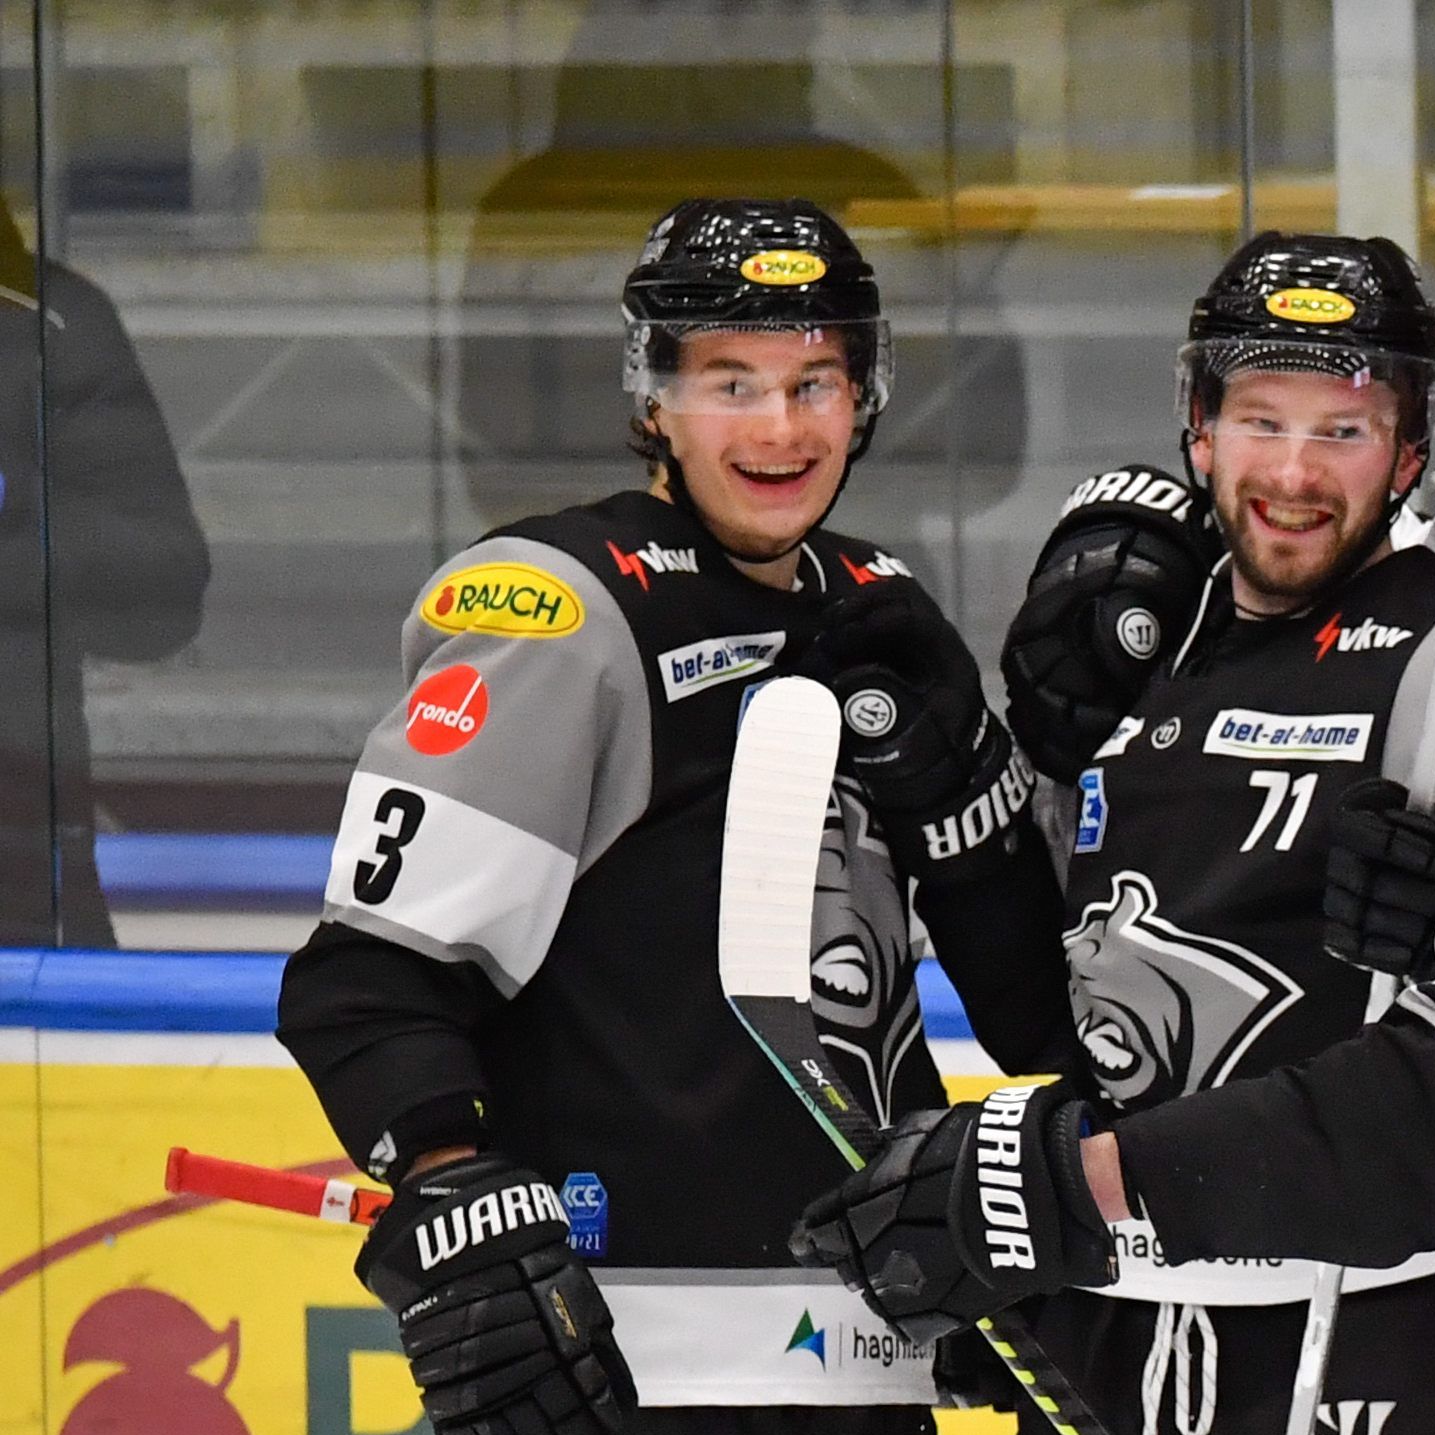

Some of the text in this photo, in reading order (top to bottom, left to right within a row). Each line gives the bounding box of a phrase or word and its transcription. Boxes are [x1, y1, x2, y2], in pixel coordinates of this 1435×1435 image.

[637, 541, 700, 574] vkw
[456, 583, 562, 626] RAUCH
[1337, 617, 1414, 652] vkw
[406, 675, 482, 733] rondo
[1218, 716, 1361, 746] bet-at-home
[922, 756, 1035, 861] RIOR
[1239, 770, 1319, 853] 71
[353, 787, 426, 906] 3
[977, 1084, 1036, 1270] ARRIOR
[415, 1182, 570, 1271] WARRI
